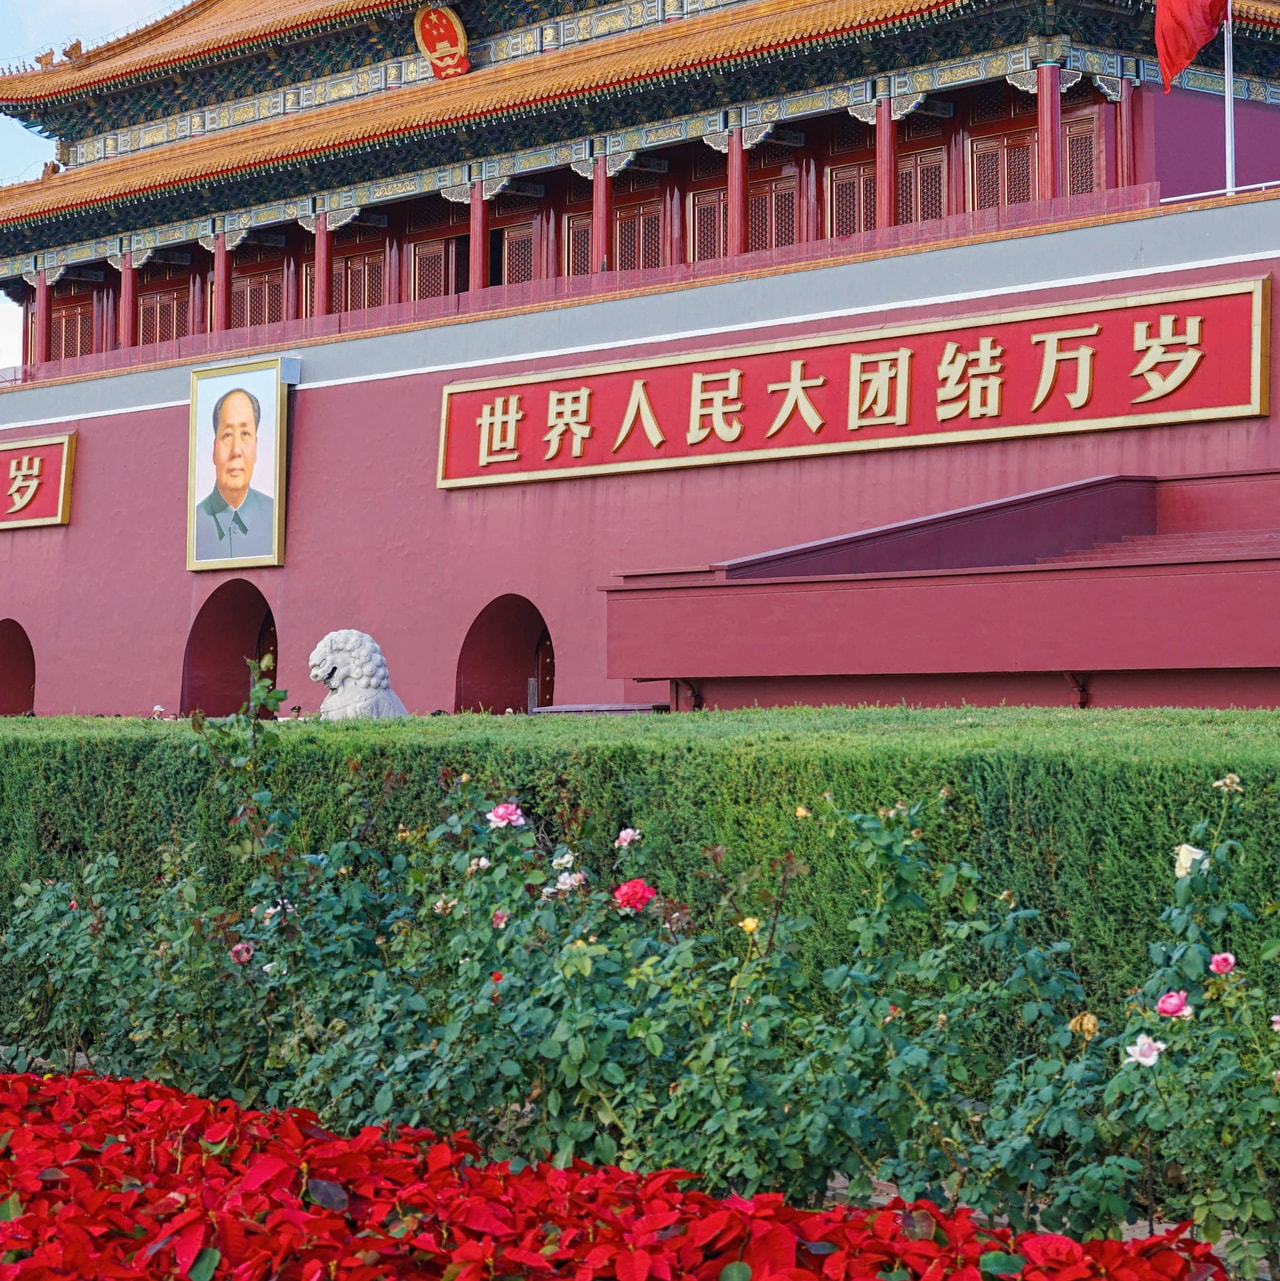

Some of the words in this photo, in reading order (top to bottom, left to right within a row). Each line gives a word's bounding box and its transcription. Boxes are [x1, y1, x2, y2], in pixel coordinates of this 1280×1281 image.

[475, 313, 1204, 467] 世界人民大团结万岁
